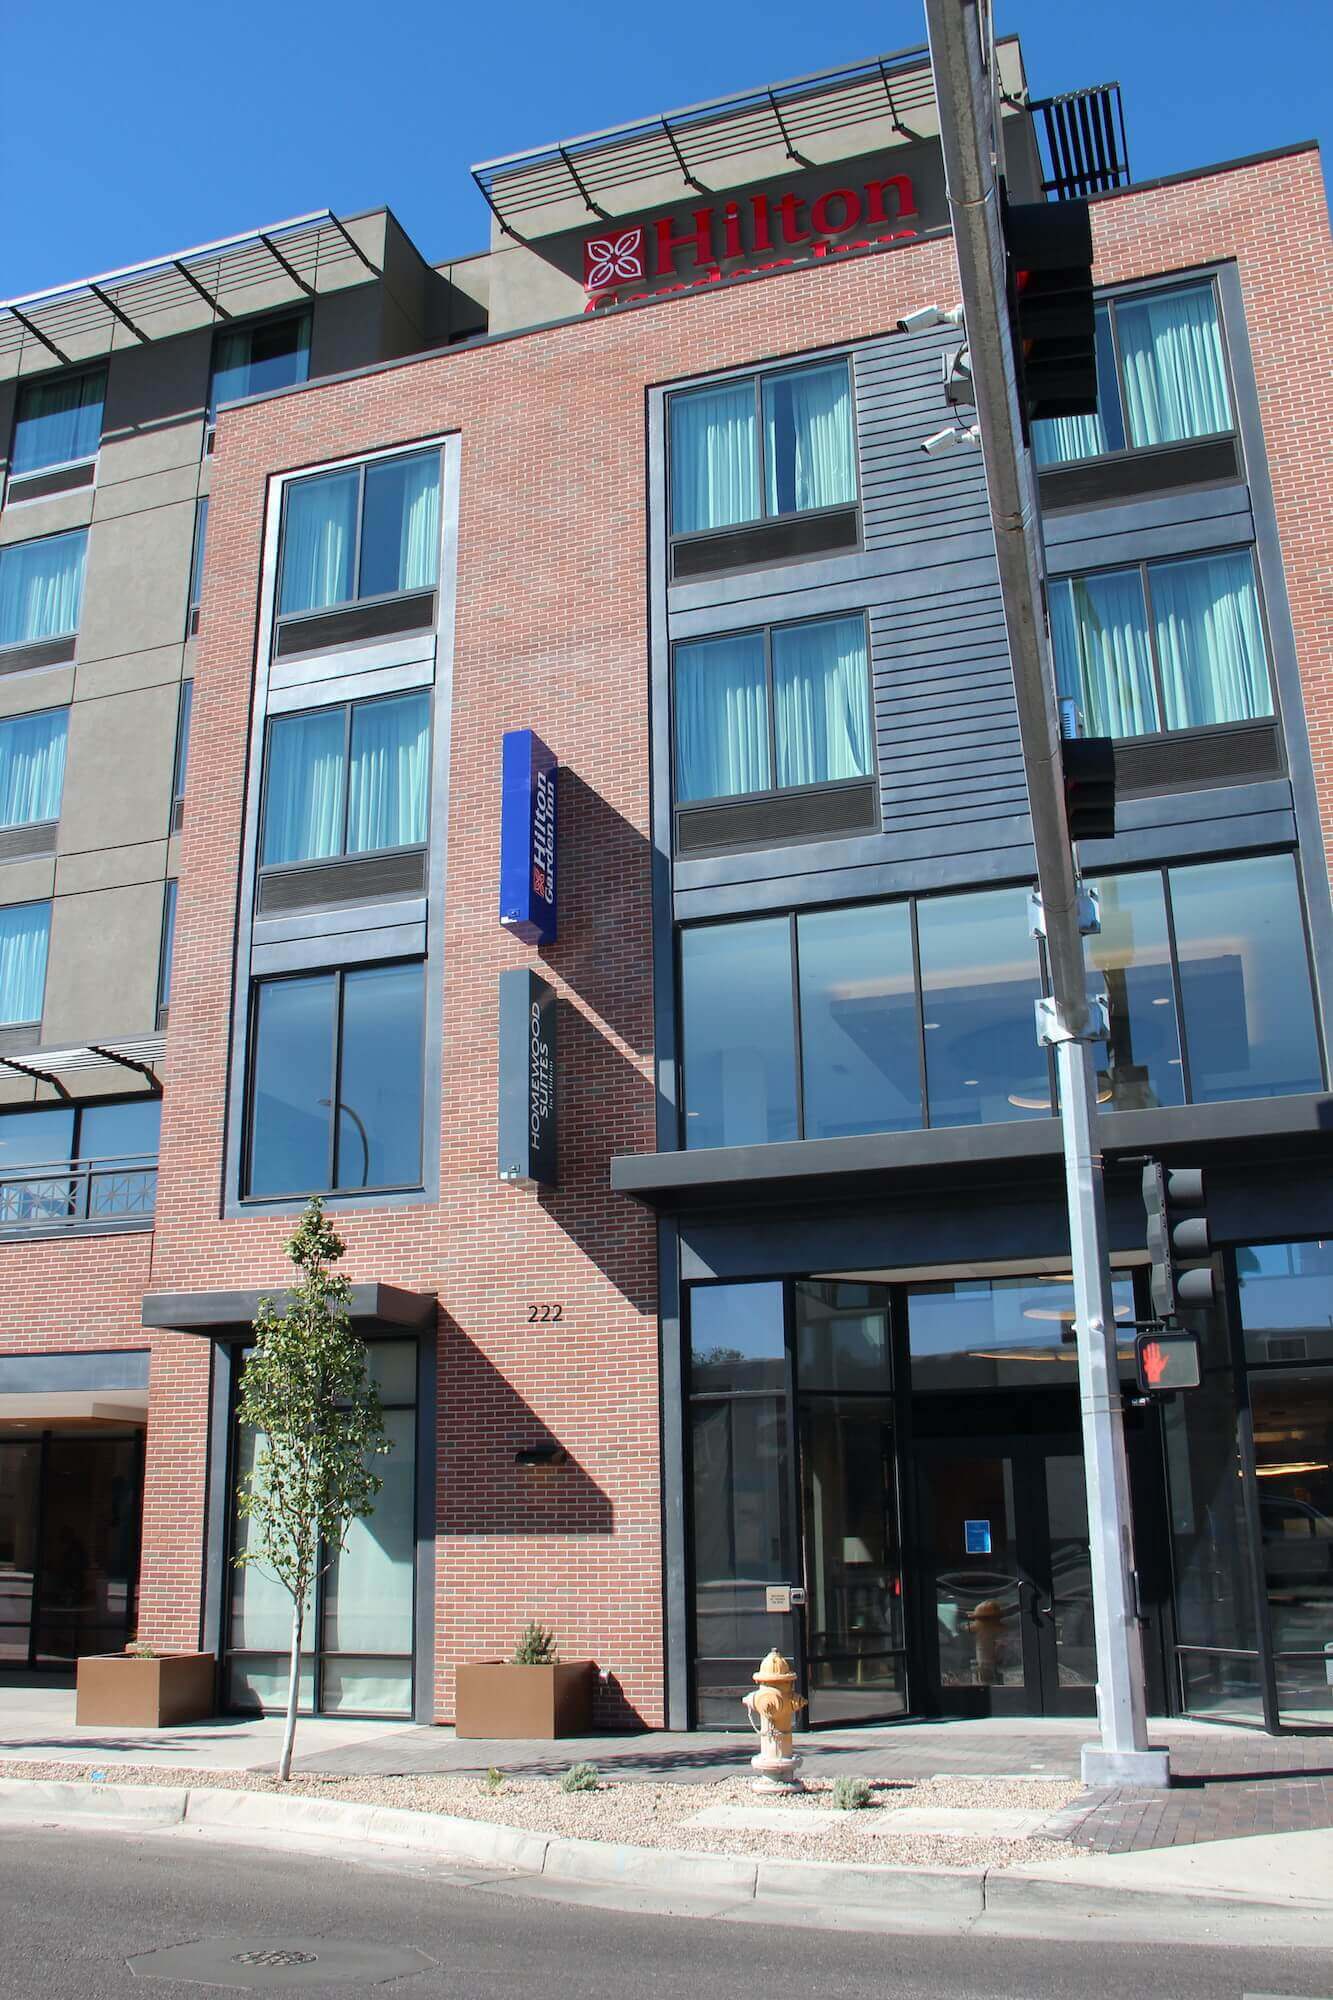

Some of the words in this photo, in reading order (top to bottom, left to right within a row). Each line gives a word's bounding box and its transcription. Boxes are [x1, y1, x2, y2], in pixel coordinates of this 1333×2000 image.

[653, 172, 919, 277] Hilton
[533, 772, 547, 871] Hilton
[545, 781, 555, 821] Inn
[545, 822, 554, 905] Garden
[531, 1001, 540, 1150] HOMEWOOD
[540, 1043, 549, 1118] SUITES
[528, 1304, 563, 1323] 222
